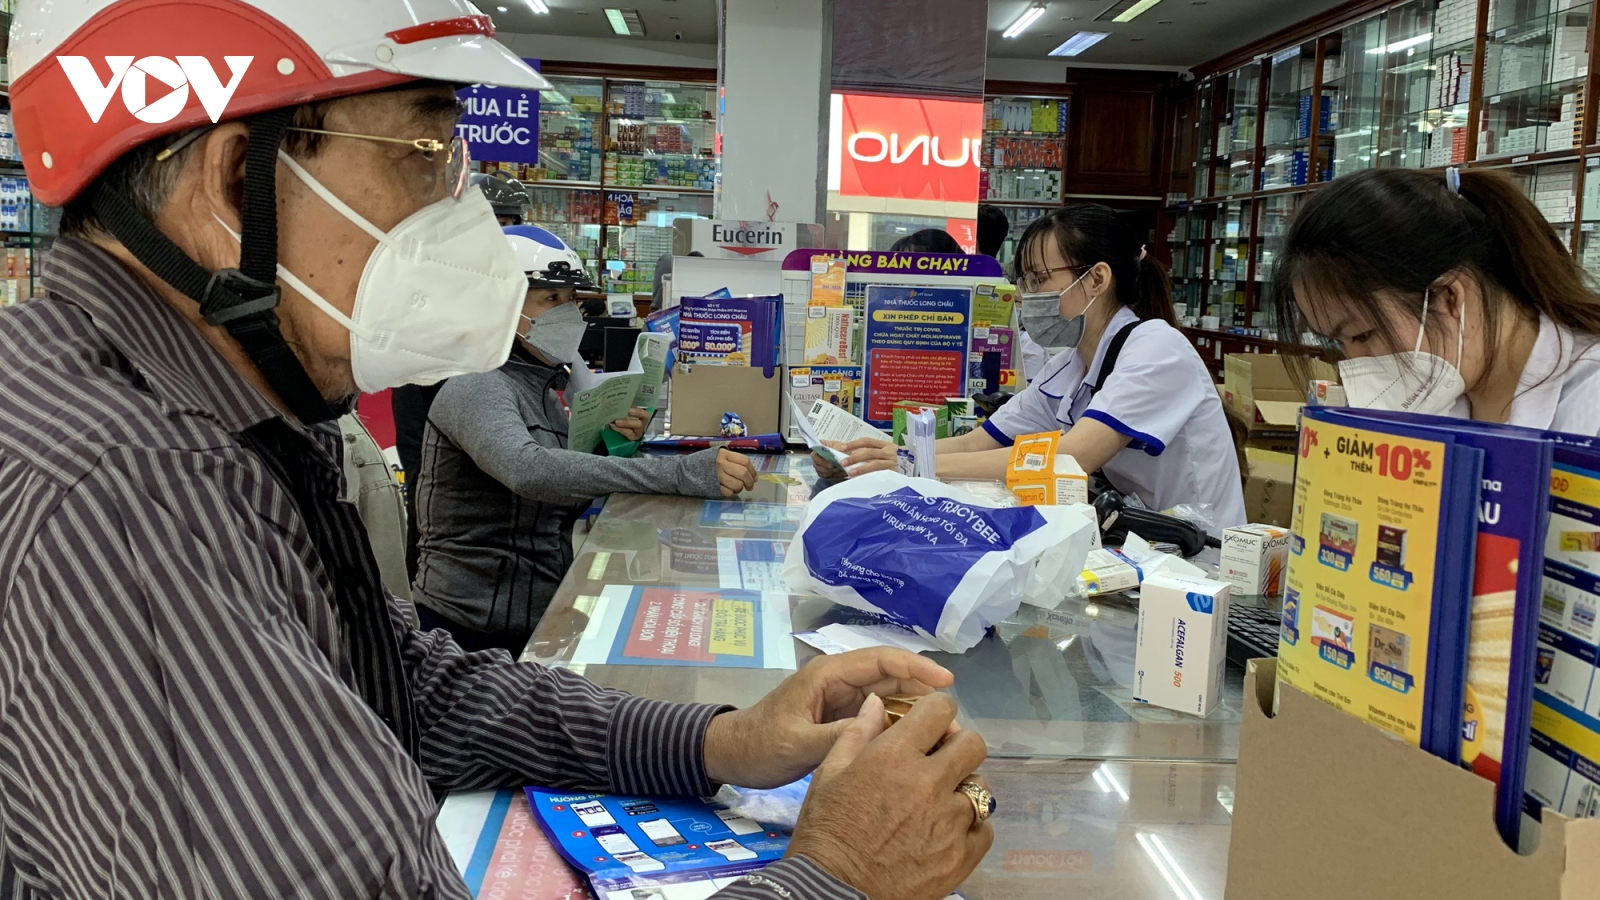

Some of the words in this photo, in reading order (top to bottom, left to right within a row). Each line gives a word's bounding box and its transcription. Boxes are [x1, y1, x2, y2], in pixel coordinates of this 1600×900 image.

[507, 94, 529, 118] LẺ
[455, 122, 530, 145] TRƯỚC
[712, 224, 783, 245] Eucerin
[877, 253, 912, 270] BÁN
[917, 257, 969, 274] CHẠY!
[898, 298, 918, 306] THUỐC
[937, 299, 954, 307] CHÂU
[898, 312, 919, 321] PHÉP
[921, 312, 935, 322] CHỈ
[937, 313, 954, 322] BÁN
[838, 314, 849, 359] NattocereBest
[999, 370, 1015, 385] 0%
[1300, 426, 1318, 459] 0%
[1336, 434, 1374, 460] GIẢM
[1375, 443, 1432, 481] 10%
[1350, 460, 1373, 474] THÊM
[1018, 492, 1038, 503] tamin
[1039, 492, 1045, 502] C
[882, 510, 907, 531] VIRUS
[924, 530, 939, 546] XA
[938, 500, 1001, 545] TRACYBEE
[954, 532, 969, 547] ĐA
[1224, 534, 1256, 546] EXOMUC
[1262, 536, 1290, 553] EXOMUC
[1373, 566, 1391, 583] 560
[1175, 618, 1187, 669] ACEFALGAN
[1323, 644, 1337, 661] 150
[1173, 670, 1182, 688] 500
[1374, 666, 1392, 684] 950
[500, 840, 524, 863] phải
[495, 865, 517, 879] kê
[525, 864, 549, 886] các
